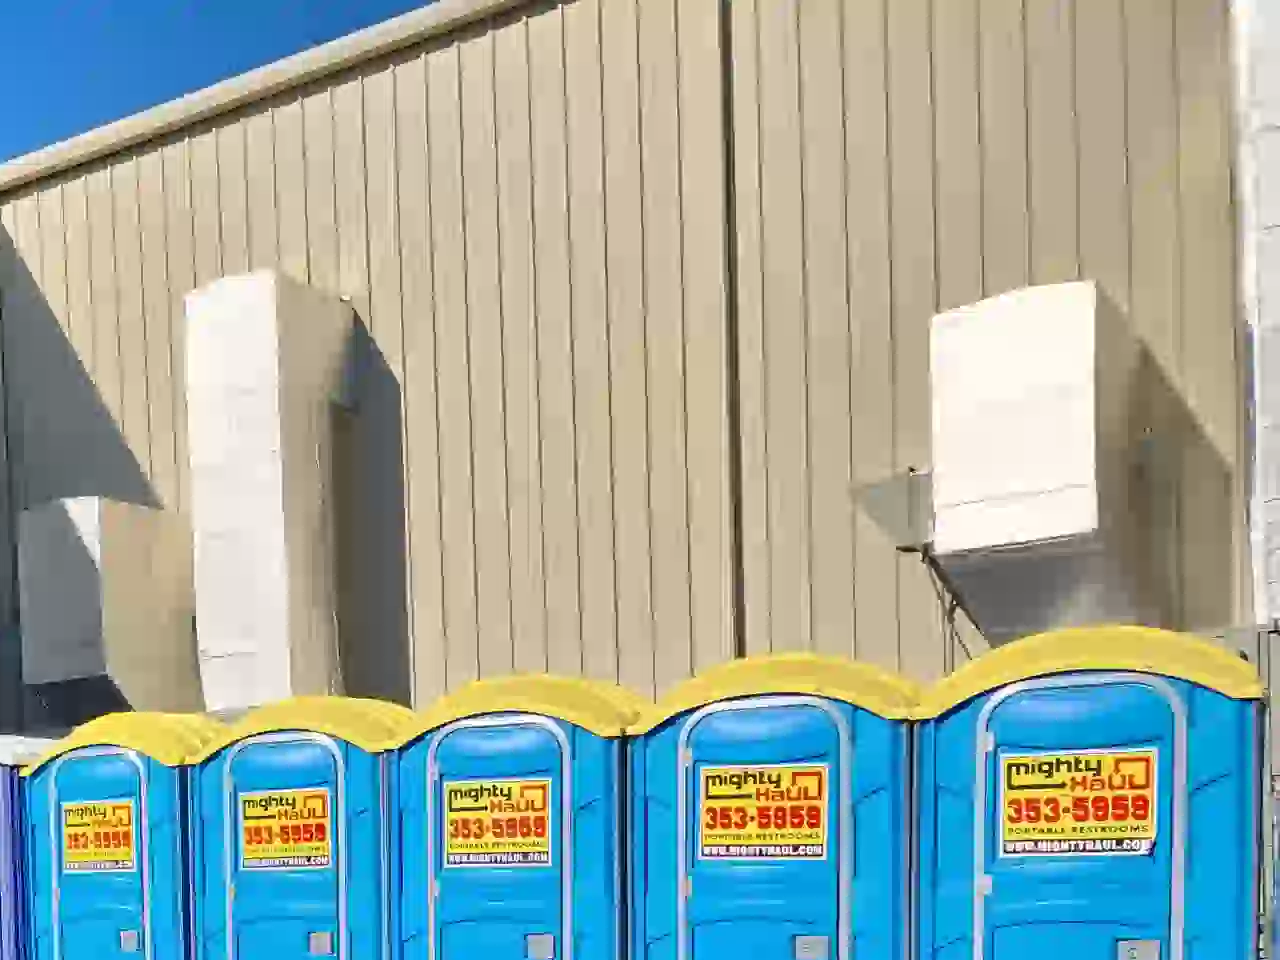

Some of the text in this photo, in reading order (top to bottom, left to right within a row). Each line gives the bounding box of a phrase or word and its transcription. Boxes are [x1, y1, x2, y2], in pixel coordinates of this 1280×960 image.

[1008, 756, 1102, 778] mighty
[706, 771, 781, 789] mighty
[449, 784, 512, 802] mighty
[243, 796, 296, 811] mighty
